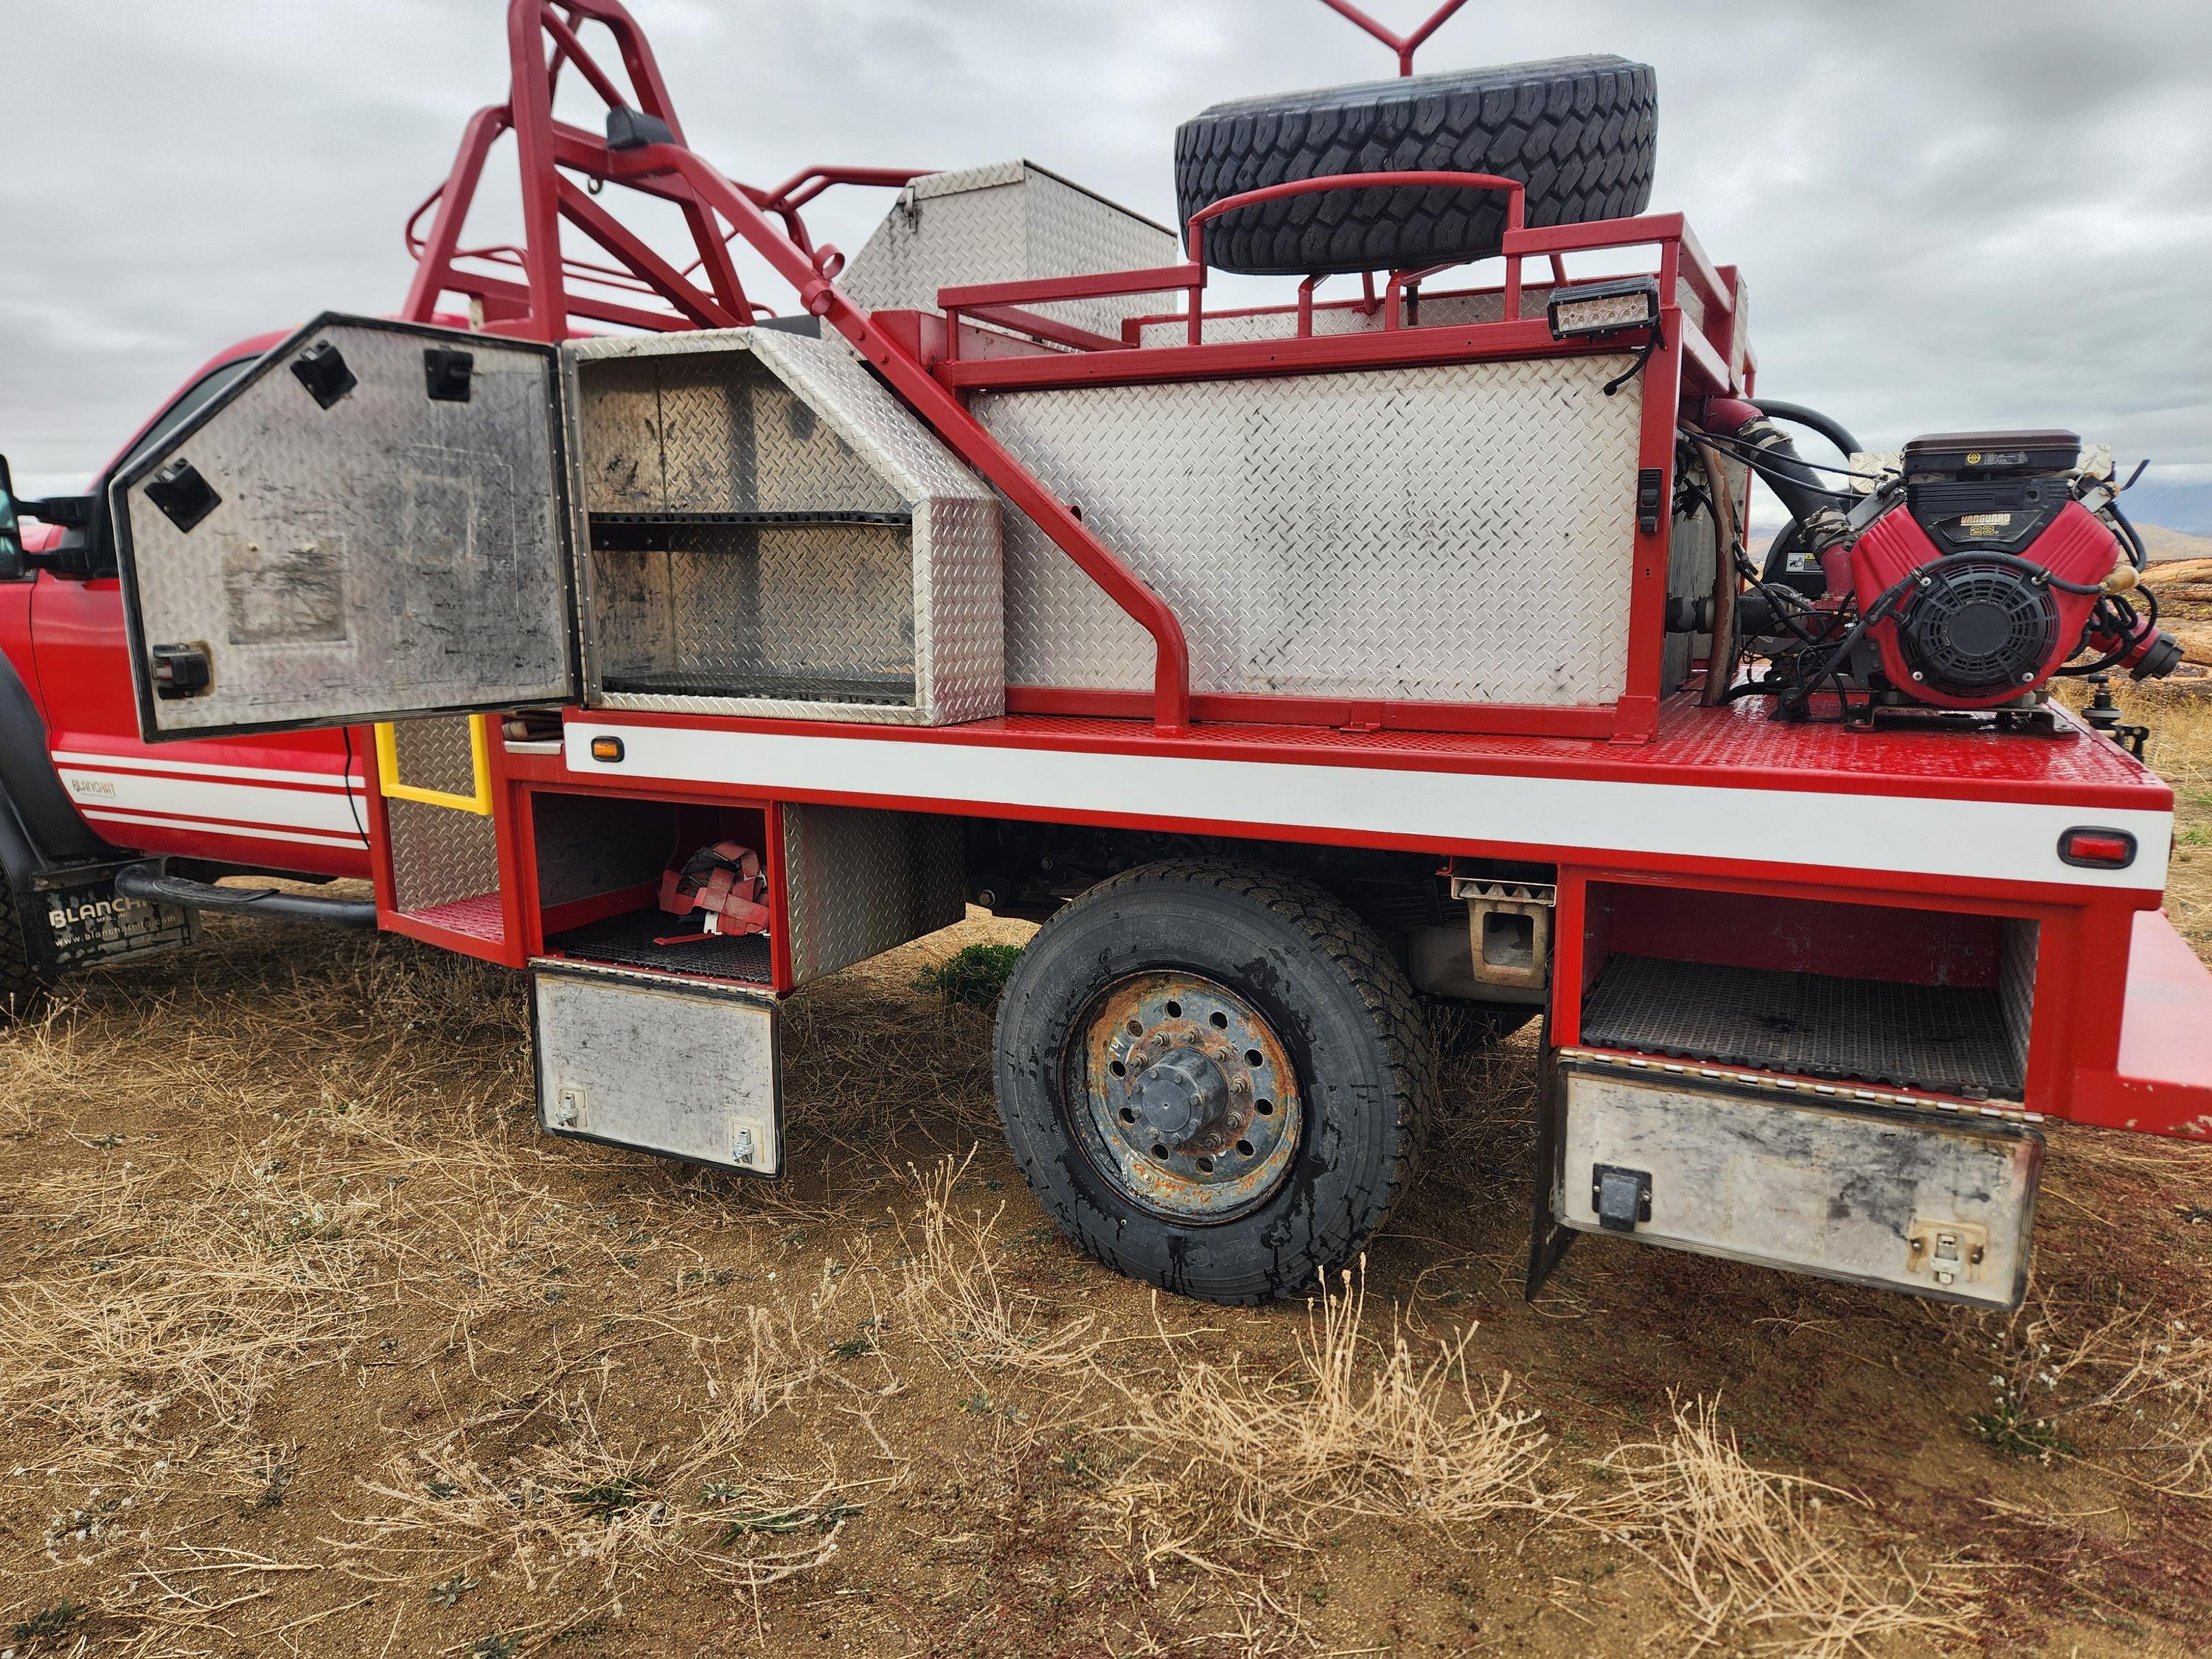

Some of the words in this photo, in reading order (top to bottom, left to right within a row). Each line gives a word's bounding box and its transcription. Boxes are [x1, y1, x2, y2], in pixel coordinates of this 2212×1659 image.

[1961, 513, 2011, 524] VANGUARD
[1970, 525, 1994, 535] 23
[72, 779, 116, 797] BLANCHAT
[49, 896, 148, 929] BLANCH
